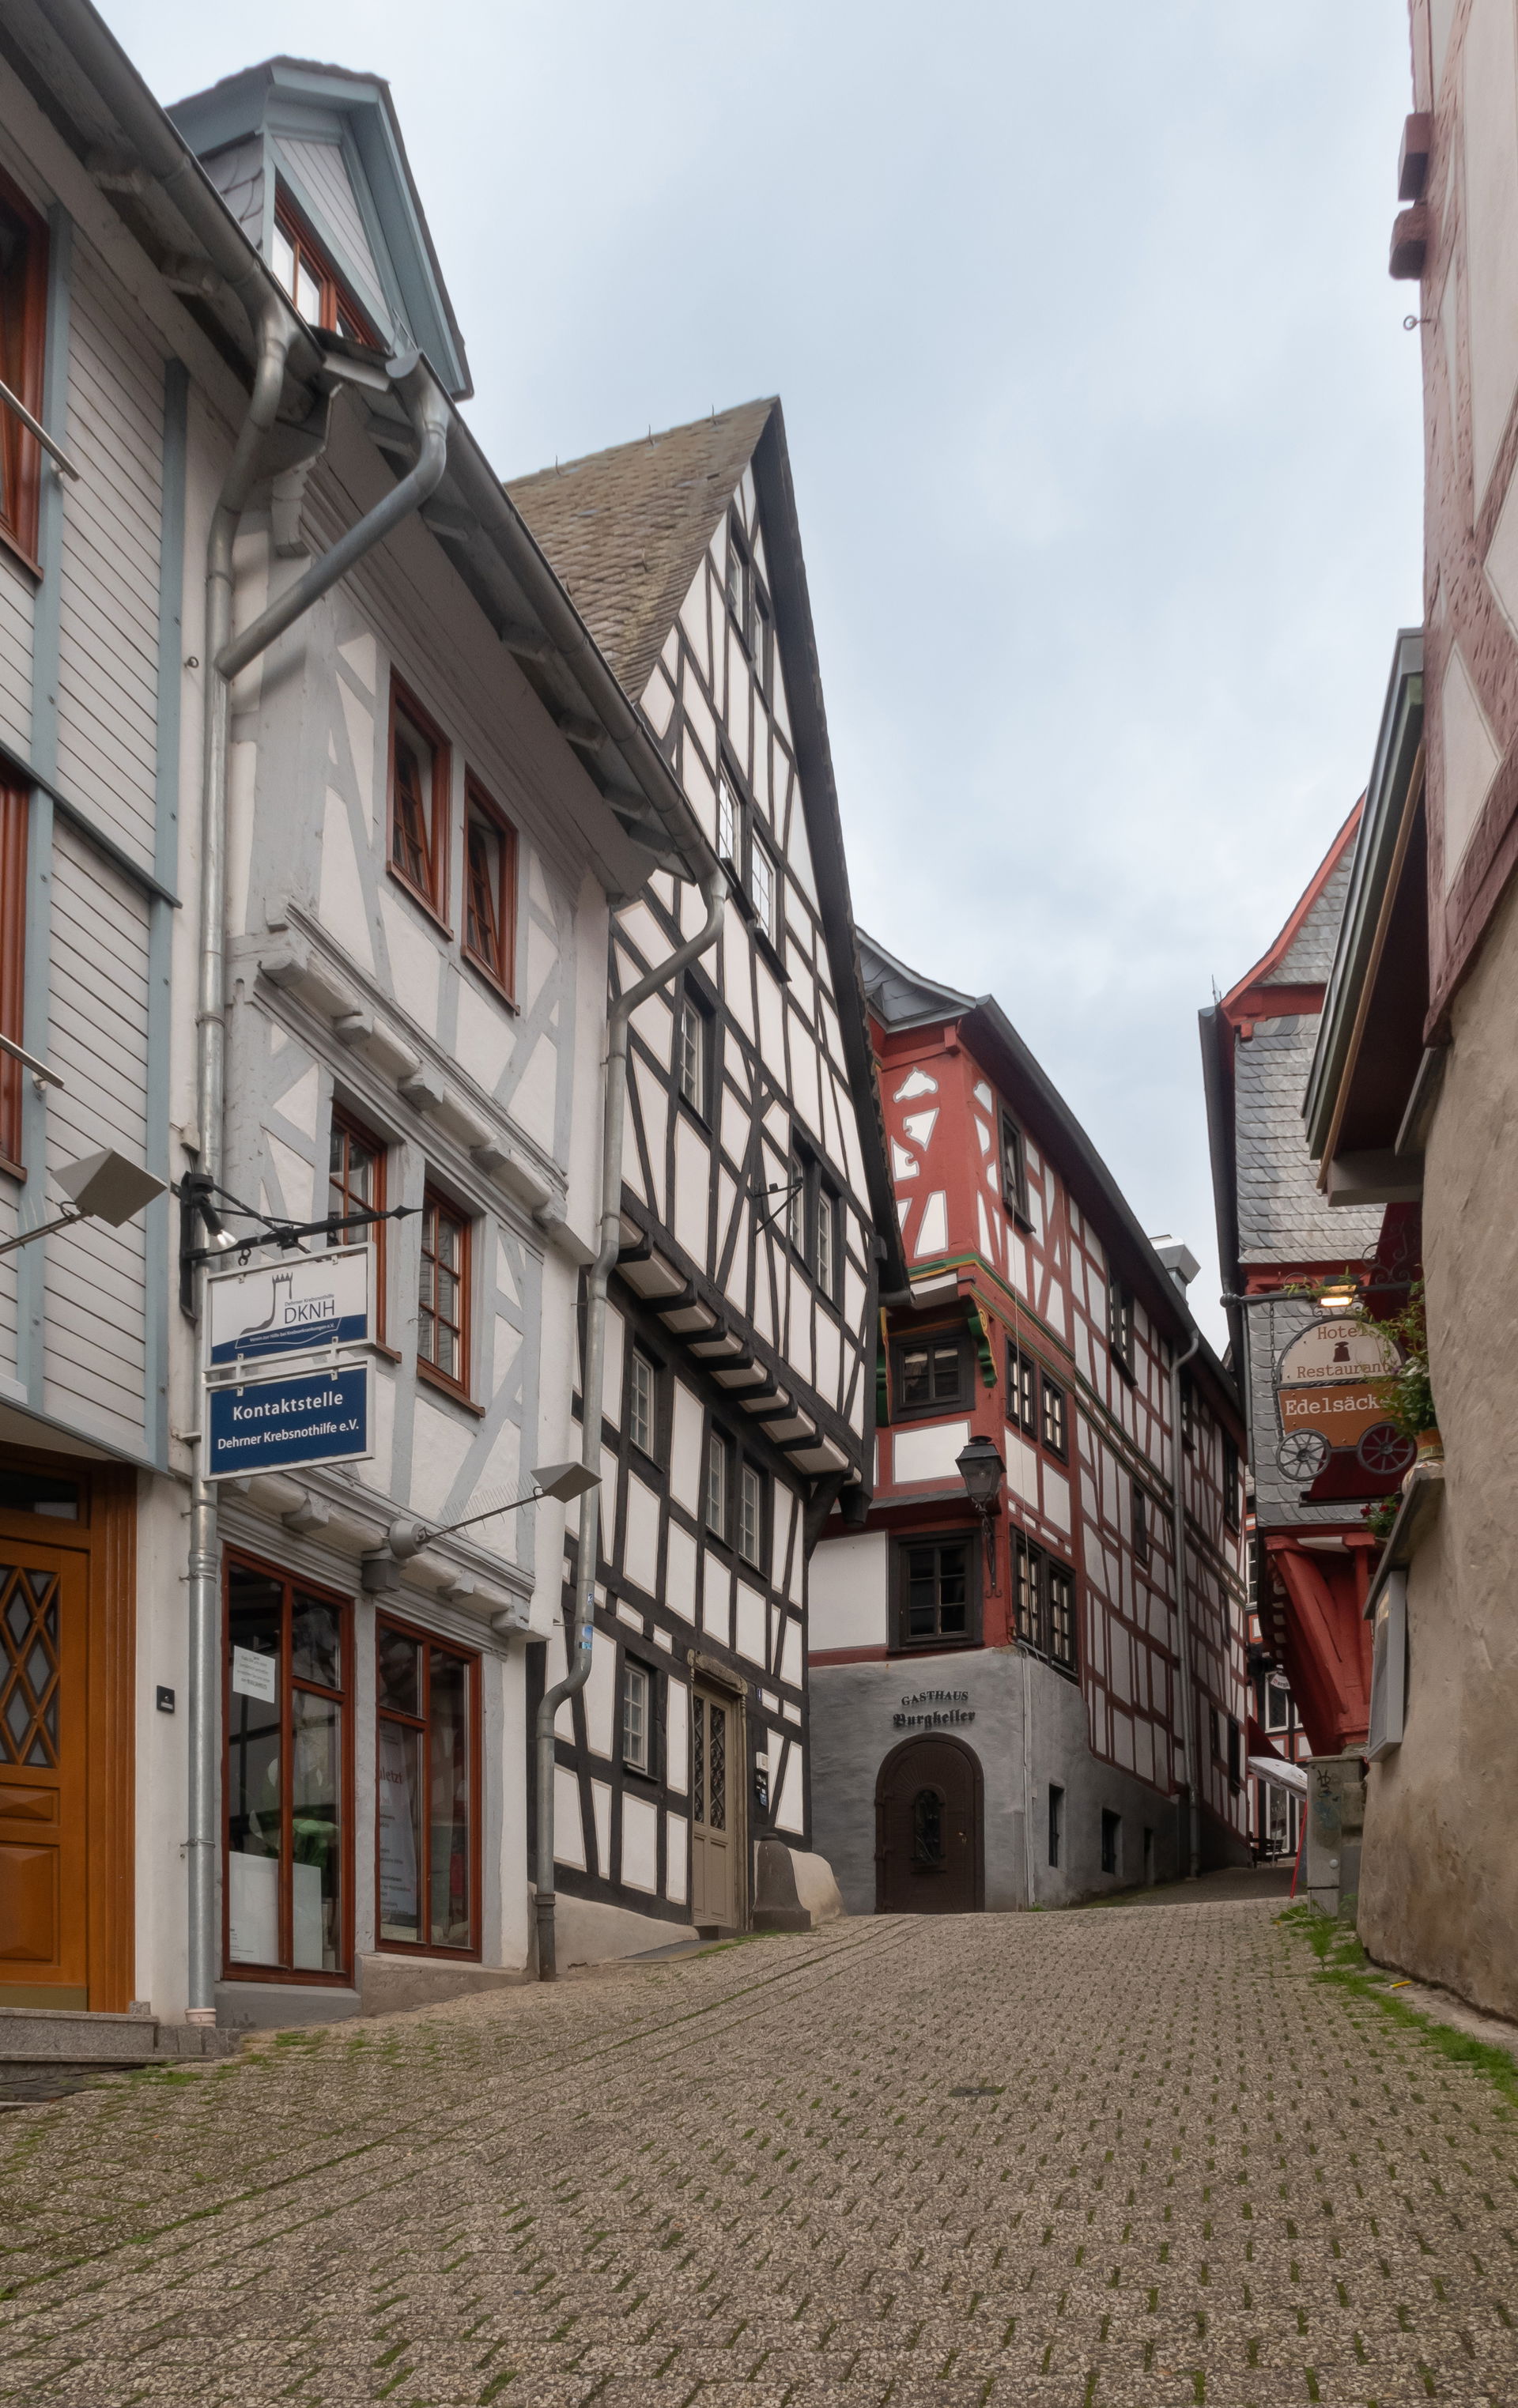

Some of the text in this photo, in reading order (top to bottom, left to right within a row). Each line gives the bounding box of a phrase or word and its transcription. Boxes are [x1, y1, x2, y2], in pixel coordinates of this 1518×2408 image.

[285, 1300, 334, 1324] DKNH
[1297, 1361, 1390, 1379] Restaurant
[233, 1391, 343, 1421] Kontaktstelle
[217, 1418, 360, 1450] Dehrner Krebsnothilfe e.V.
[901, 1690, 969, 1706] GASTHAUS
[893, 1709, 976, 1729] Burgkeller
